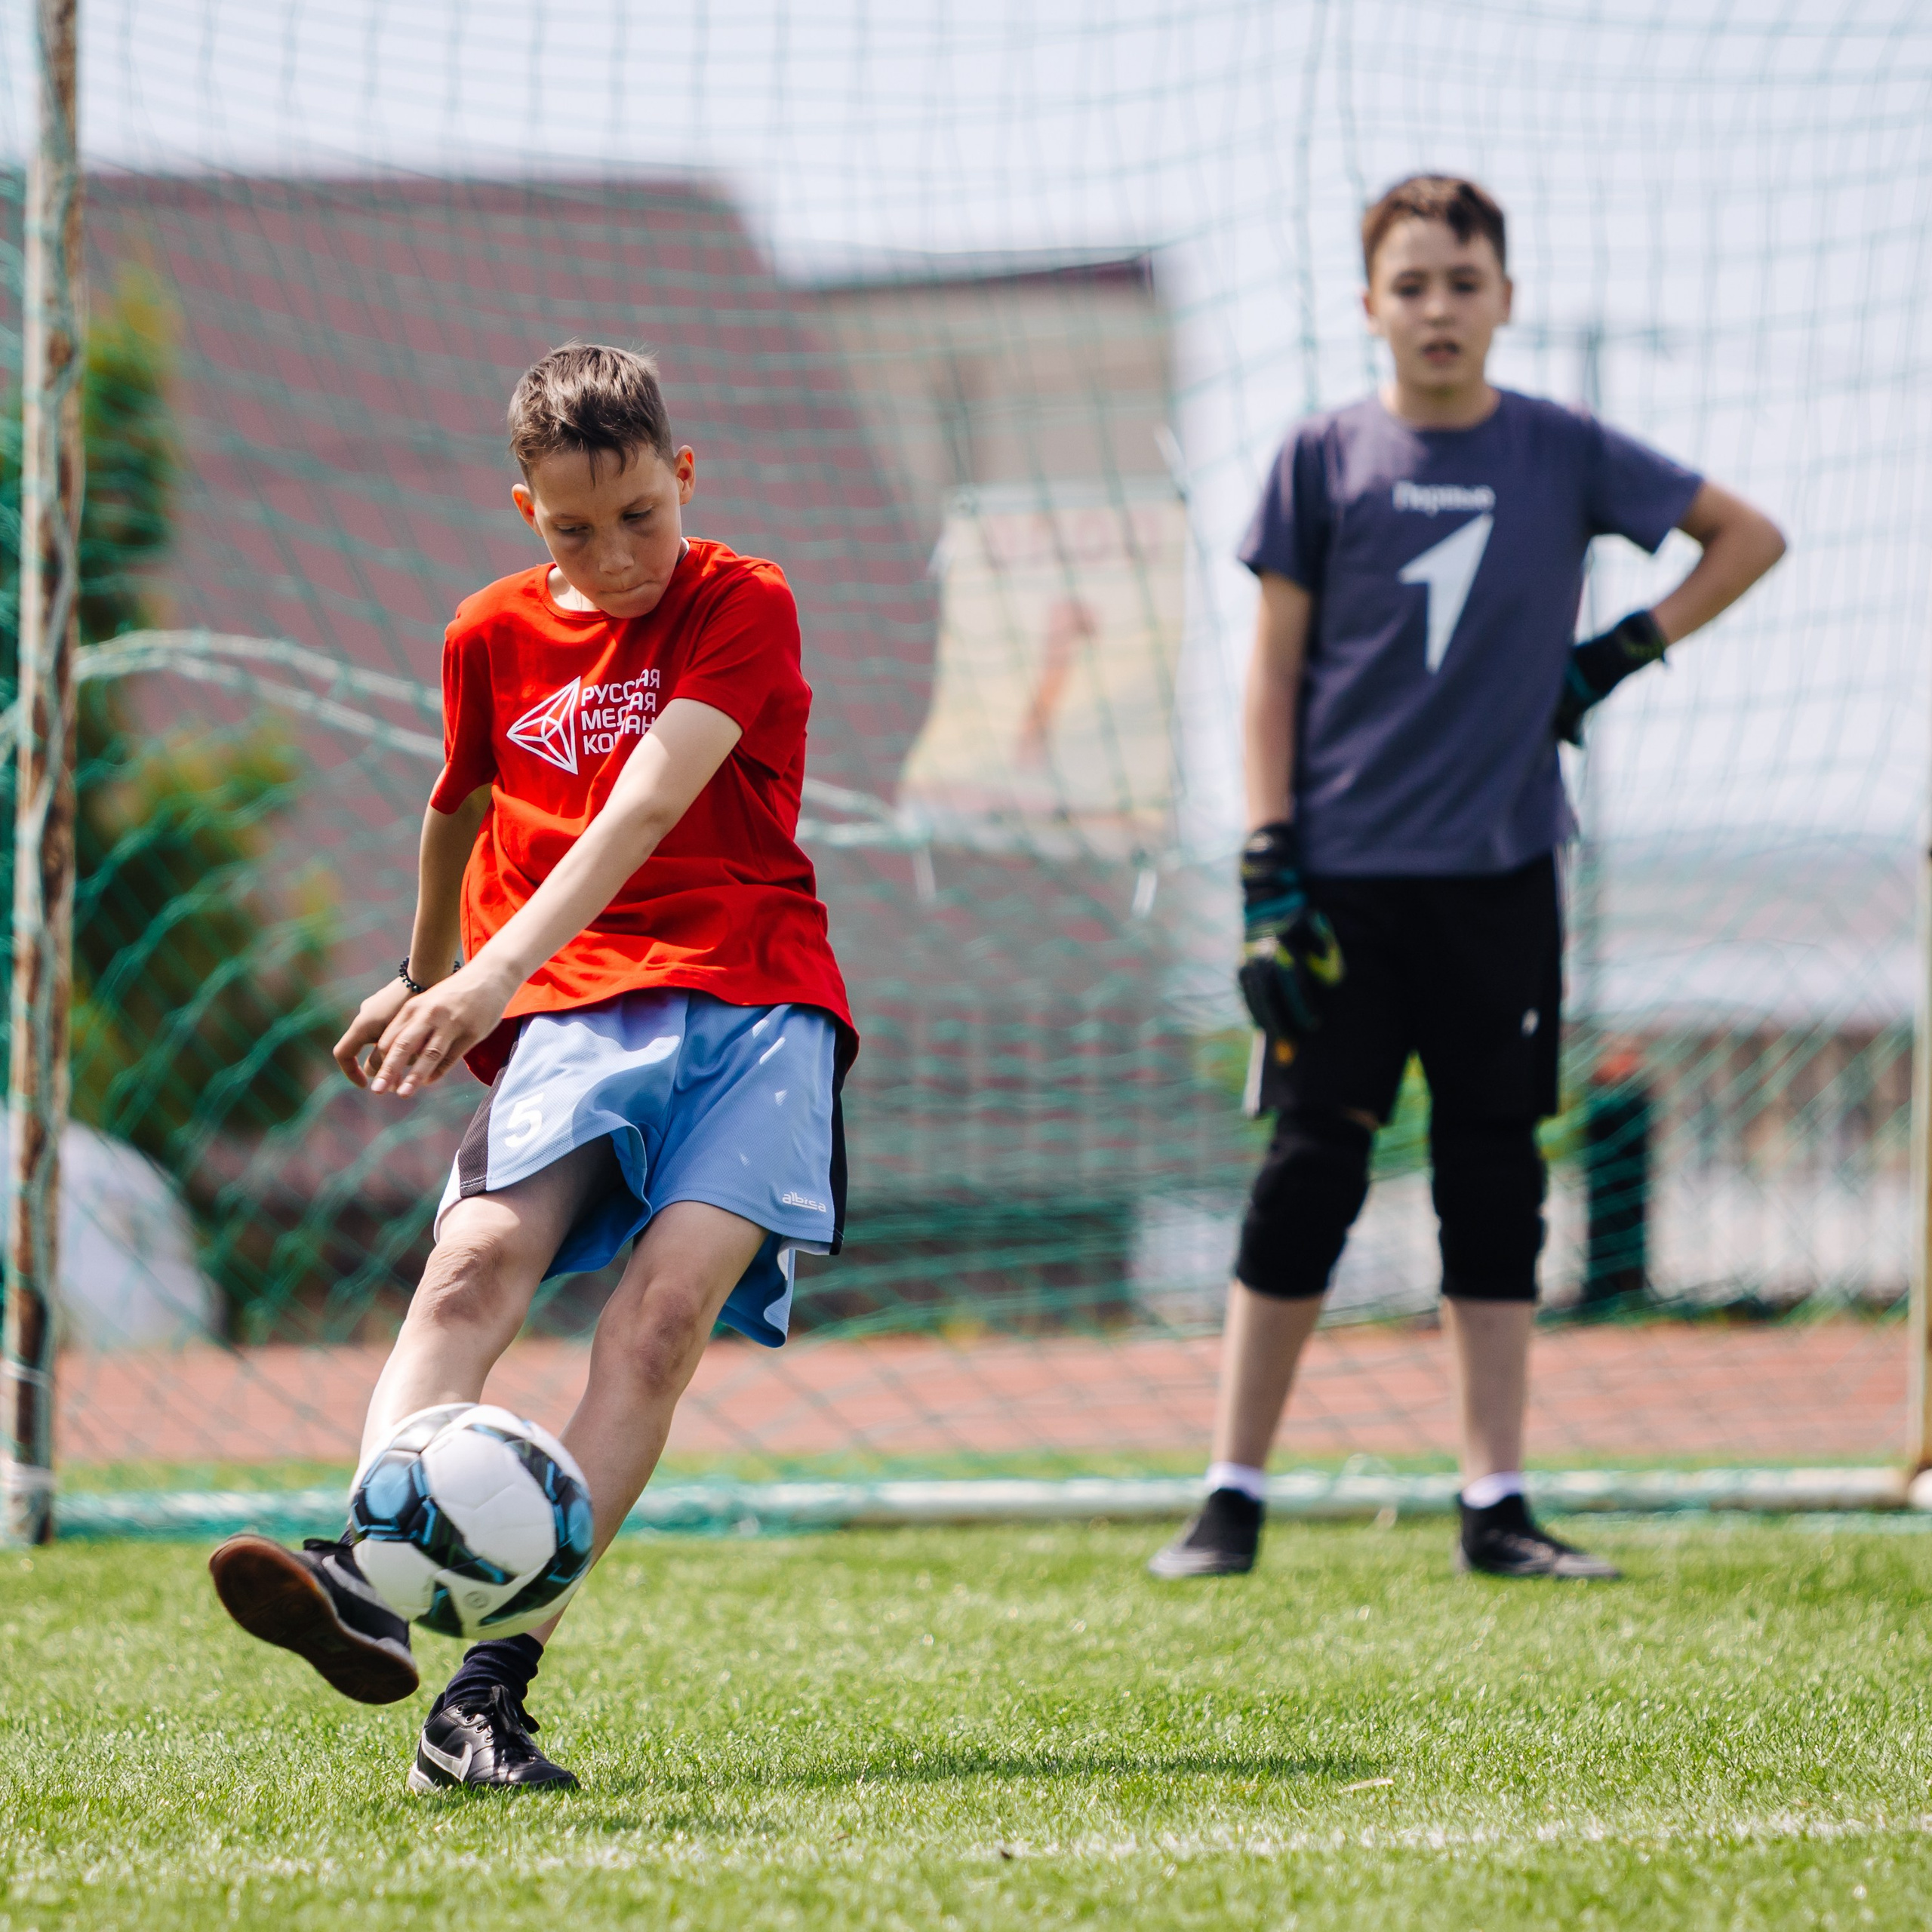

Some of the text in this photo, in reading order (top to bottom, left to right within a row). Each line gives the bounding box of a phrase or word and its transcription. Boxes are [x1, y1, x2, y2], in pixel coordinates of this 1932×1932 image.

[581, 669, 660, 706] РУССАЯ
[581, 692, 656, 731] МЕДАЯ
[505, 1092, 544, 1147] 5
